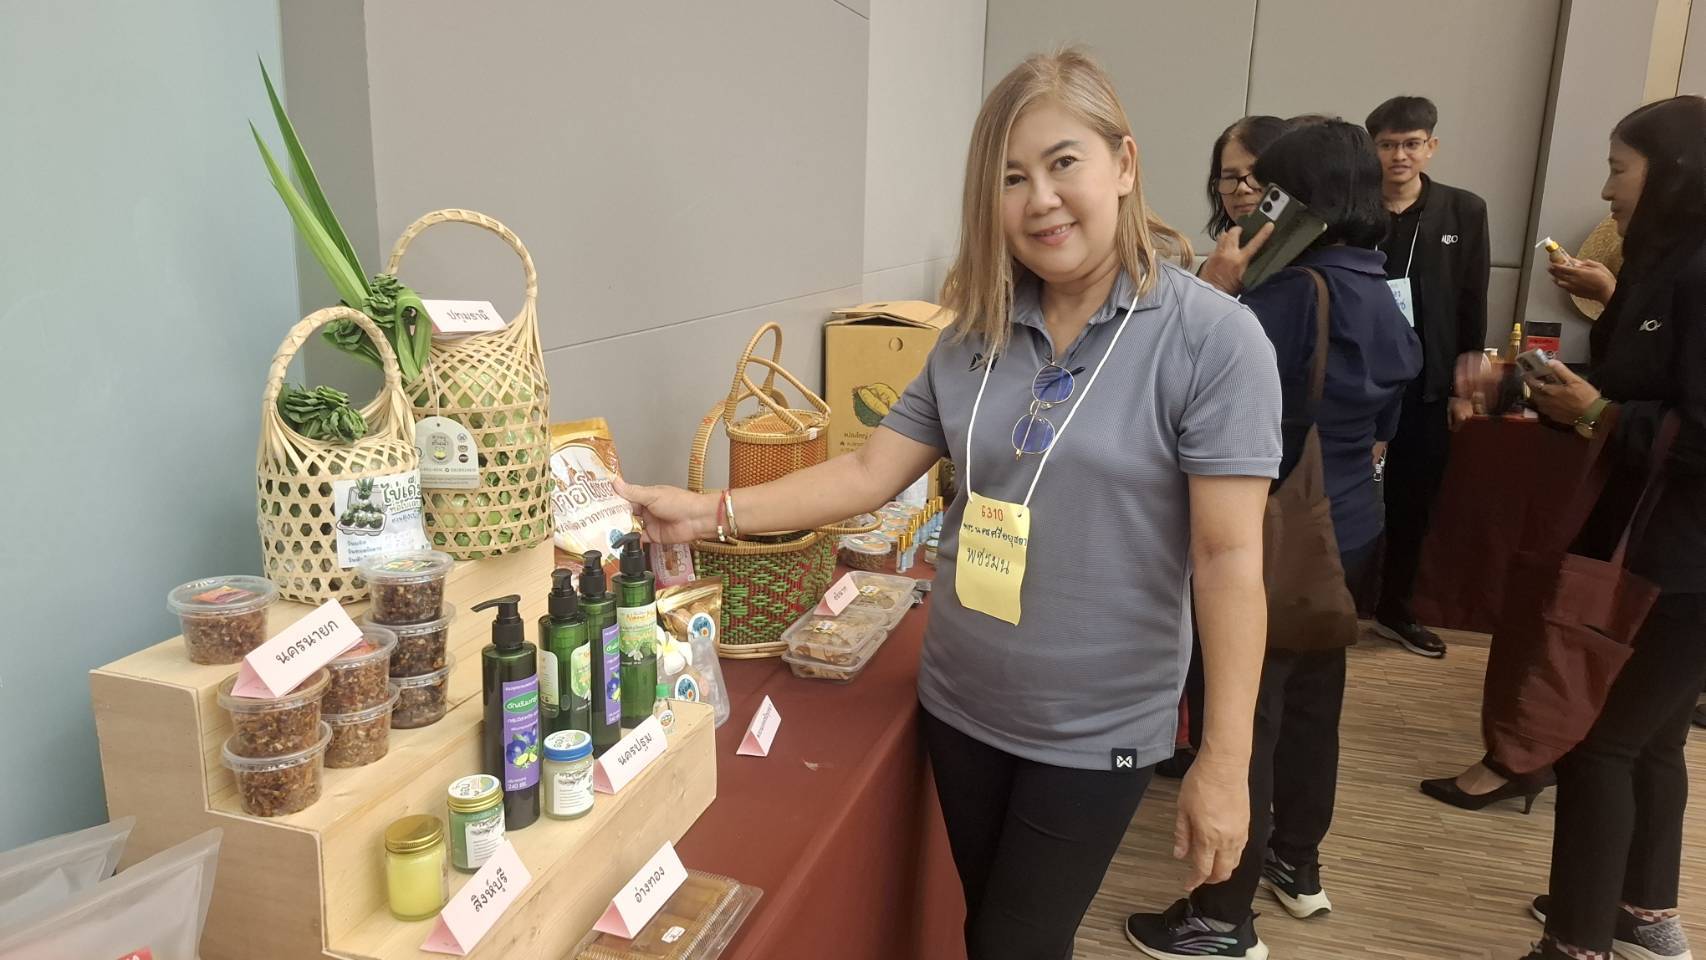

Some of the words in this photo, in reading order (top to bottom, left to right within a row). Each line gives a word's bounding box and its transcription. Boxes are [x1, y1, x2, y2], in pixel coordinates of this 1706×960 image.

[447, 309, 490, 323] ปทุมธานี
[275, 619, 339, 664] นครนายก
[617, 733, 653, 766] นครปฐม
[470, 867, 508, 913] สิงห์บุรี
[634, 866, 666, 904] อ่างทอง
